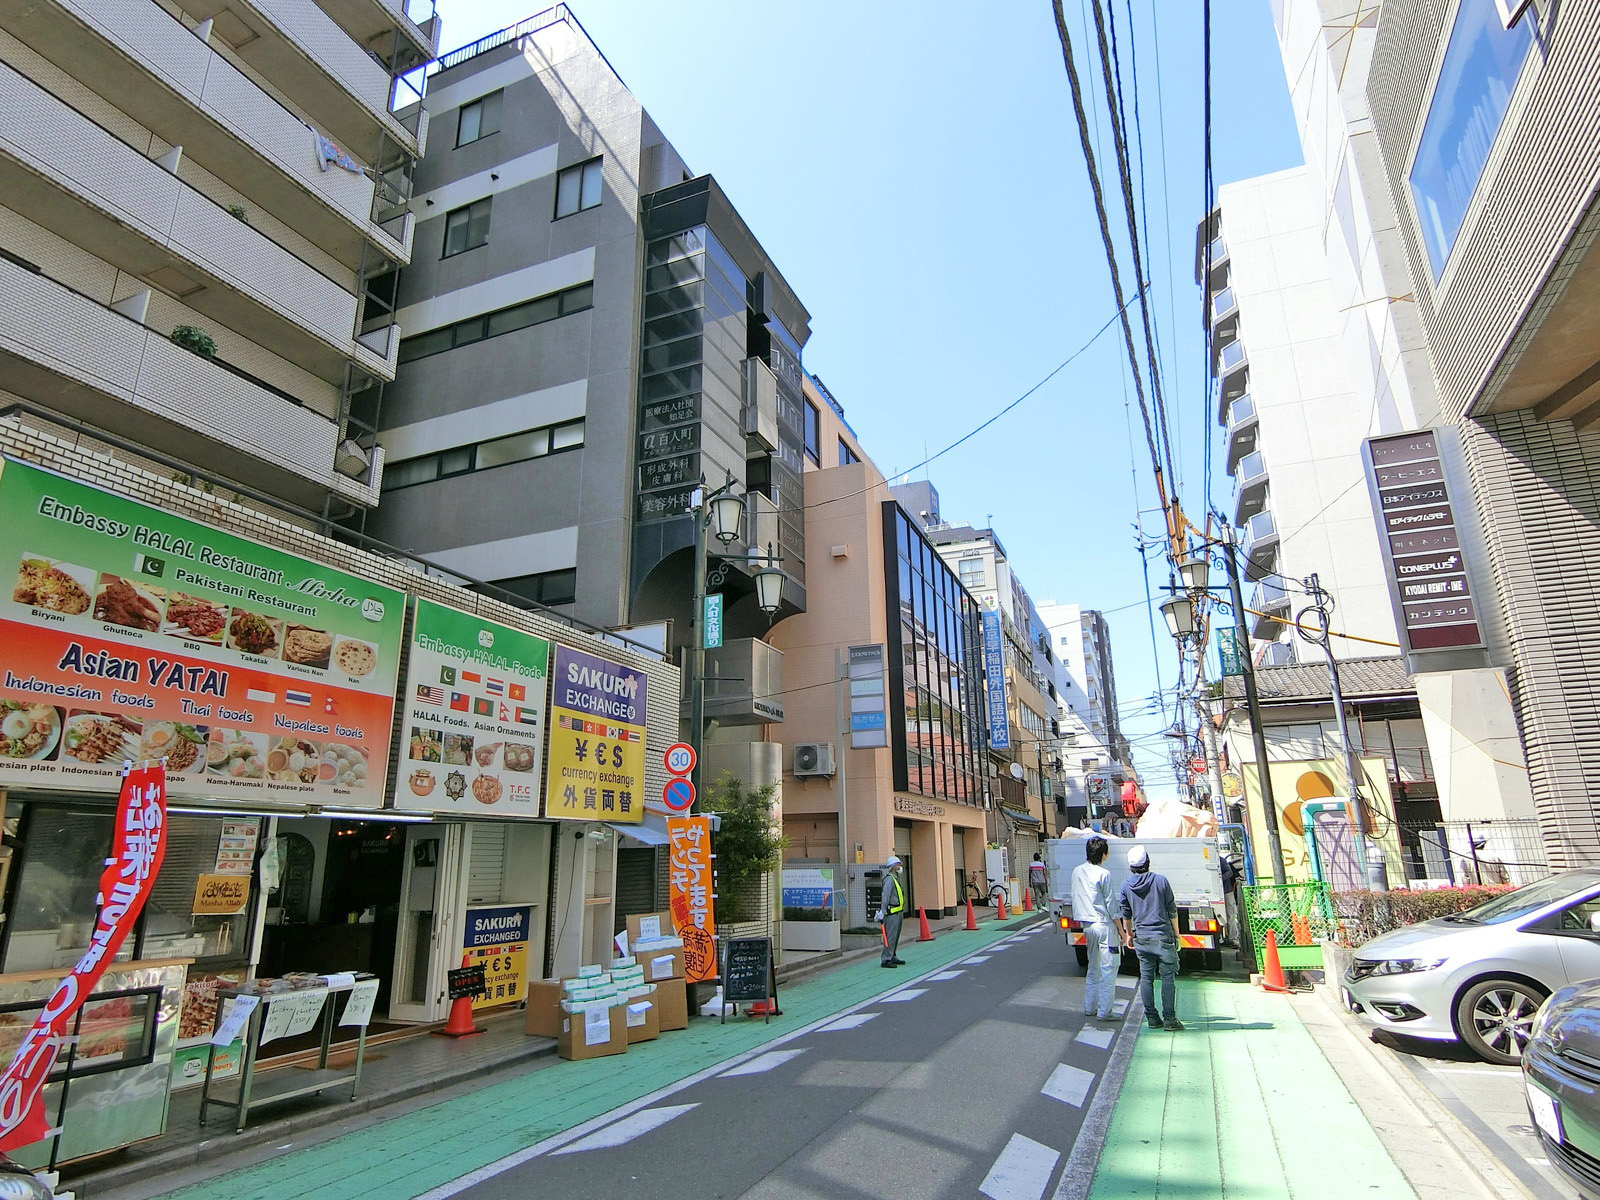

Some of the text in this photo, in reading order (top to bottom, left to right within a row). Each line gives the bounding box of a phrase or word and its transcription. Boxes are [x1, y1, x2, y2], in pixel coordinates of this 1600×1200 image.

[645, 398, 694, 418] 医療法人社団
[646, 457, 689, 475] 形成外科
[652, 470, 683, 485] 皮膚科
[642, 493, 691, 513] 美容外科
[39, 496, 130, 537] Embassy
[133, 526, 195, 560] HALAL
[200, 546, 284, 586] Restaurant
[175, 568, 318, 618] Pakistani Restaurant
[1405, 585, 1428, 596] KYODAI
[1428, 582, 1447, 594] REMIT
[31, 608, 66, 623] Biryani
[1409, 607, 1468, 619] カンテック
[103, 624, 143, 640] Ghuttoca
[183, 642, 201, 651] BBQ
[241, 654, 268, 665] Takatak
[417, 633, 541, 680] Embassy HALAL Foods
[58, 642, 229, 699] Asian YATAI
[287, 664, 324, 677] Various Nan
[568, 663, 636, 699] SAKURA
[984, 615, 1007, 743] 東京早稲田外国語学校
[4, 670, 155, 709] Indonesian foods
[180, 698, 254, 724] Thai foods
[567, 689, 627, 718] EXCHANGE
[274, 713, 364, 740] Nepalese foods
[413, 710, 442, 724] HALAL
[474, 721, 495, 733] Asian
[497, 726, 536, 740] Ornaments
[595, 743, 607, 766] €
[613, 745, 623, 769] $
[671, 752, 688, 767] 30
[0, 762, 56, 774] esian plate
[61, 766, 113, 777] Indonesian
[164, 775, 186, 784] apao
[206, 777, 264, 789] Nama-Harumaki
[562, 767, 635, 788] currency exchange
[267, 782, 315, 793] Nepalese plate
[510, 784, 531, 795] T.F.C
[563, 784, 632, 813] 外貨両替
[475, 916, 521, 931] SAKURA
[474, 931, 514, 944] EXCHANGE
[493, 958, 501, 972] €
[504, 956, 512, 971] $
[454, 976, 479, 987] OPEN
[495, 972, 519, 982] exchange
